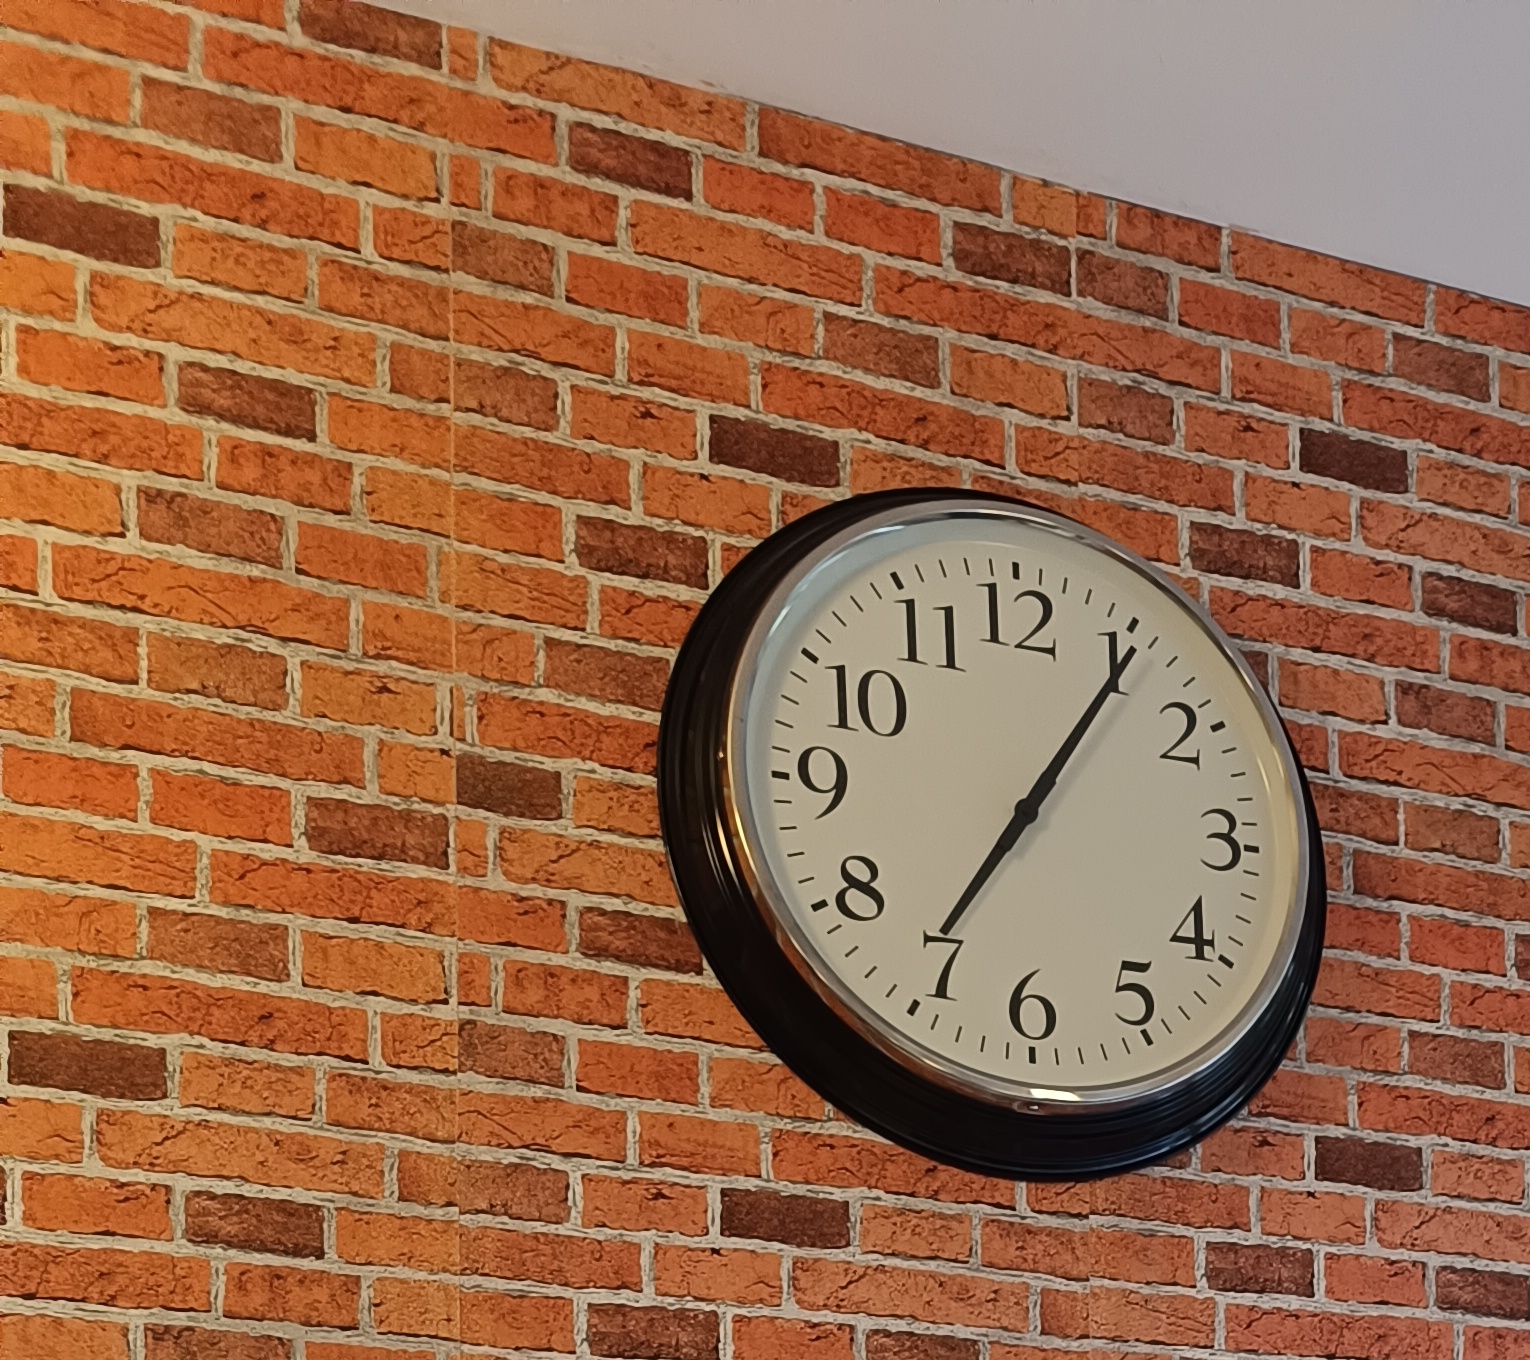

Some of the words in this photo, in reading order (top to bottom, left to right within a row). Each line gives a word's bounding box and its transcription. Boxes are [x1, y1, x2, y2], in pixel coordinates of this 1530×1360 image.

[897, 597, 967, 673] 11
[977, 582, 1057, 662] 12
[1097, 630, 1130, 696] 1
[825, 664, 908, 738] 10
[1158, 701, 1201, 771] 2
[796, 745, 849, 820] 9
[1199, 808, 1242, 872] 3
[835, 855, 885, 922] 8
[1168, 895, 1216, 963] 4
[922, 930, 965, 1001] 7
[1114, 959, 1156, 1027] 5
[1008, 968, 1058, 1041] 6
